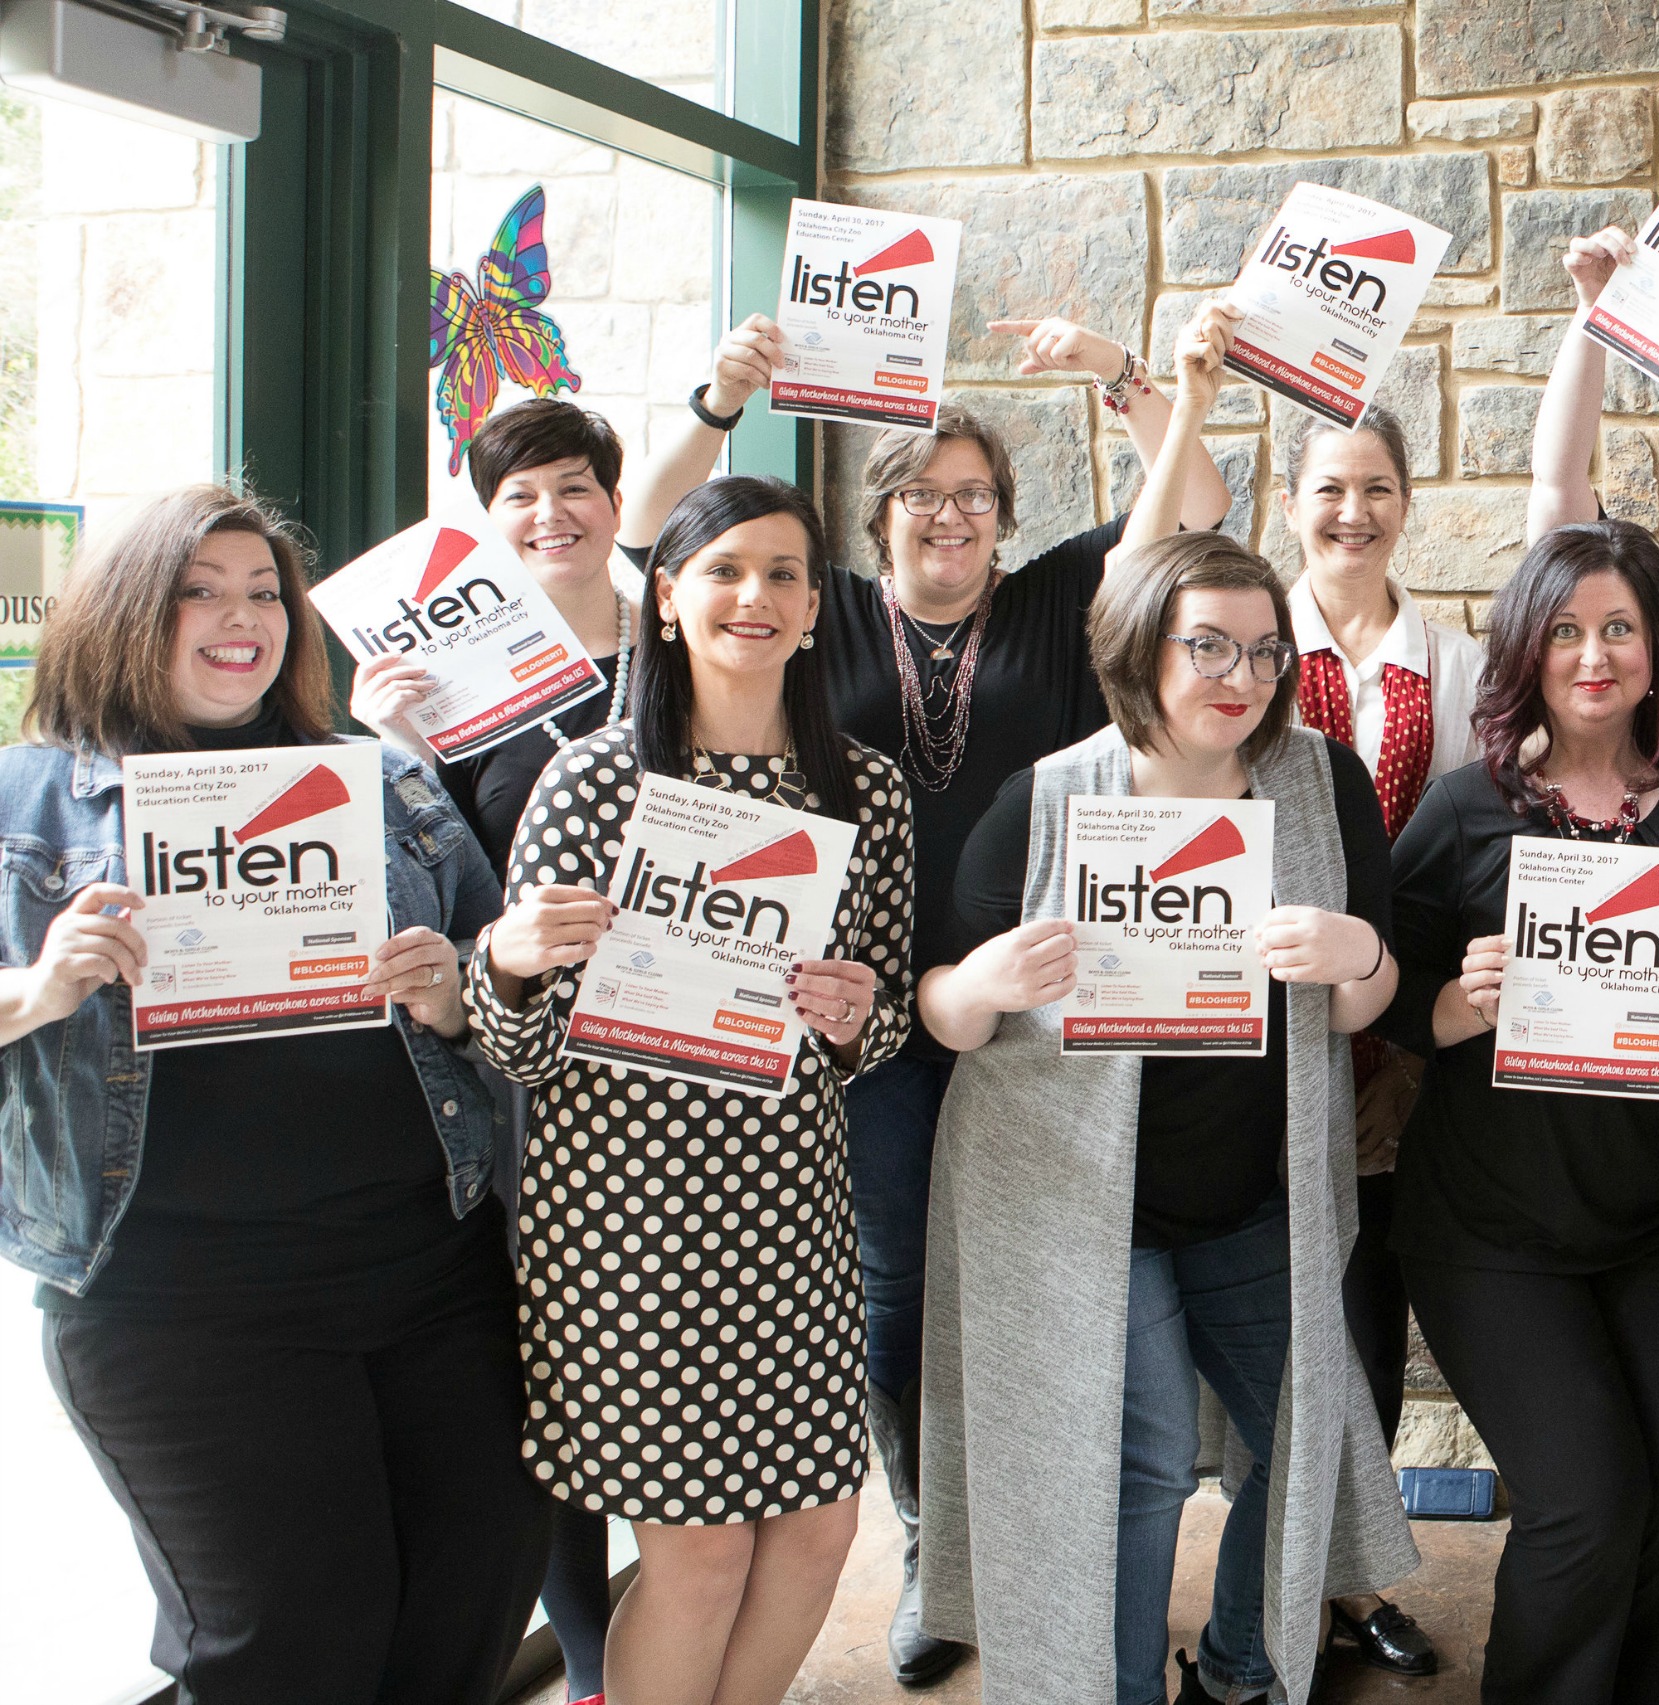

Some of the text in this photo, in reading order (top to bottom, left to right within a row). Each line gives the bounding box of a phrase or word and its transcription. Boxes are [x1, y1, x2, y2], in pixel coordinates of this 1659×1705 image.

[1260, 226, 1386, 313] listen
[790, 254, 918, 318] listen
[1289, 274, 1387, 328] to your mother
[826, 306, 929, 331] to your mother
[1320, 304, 1378, 339] Oklahoma City
[863, 326, 924, 343] Oklahoma City
[876, 375, 926, 387] #BLOGHER17
[351, 578, 506, 657] listen
[420, 597, 524, 656] to your mother
[467, 610, 529, 645] Oklahoma City
[134, 762, 268, 779] Sunday, April 30, 2017
[135, 780, 237, 794] Oklahoma City Zoo
[136, 794, 227, 806] Education Center
[647, 788, 760, 823] Sunday, April 30, 2017
[640, 814, 717, 839] Education Center
[644, 803, 729, 830] Oklahoma City Zoo
[143, 826, 338, 896] listen
[1518, 862, 1593, 875] Oklahoma City Zoo
[203, 881, 357, 911] to your mother
[619, 847, 789, 944] listen
[1077, 864, 1232, 924] listen
[263, 900, 353, 916] Oklahoma City
[665, 919, 797, 962] to your mother
[1122, 921, 1246, 943] to your mother
[1168, 940, 1242, 952] Oklahoma City
[293, 959, 365, 974] #BLOGHER17
[710, 949, 789, 977] Oklahoma City
[1557, 960, 1573, 975] to
[1577, 966, 1614, 984] your
[1188, 995, 1247, 1004] #BLOGHER17
[1600, 981, 1649, 993] Oklahoma
[716, 1015, 781, 1035] #BLOGHER17
[1072, 1022, 1097, 1036] Giving
[1097, 1022, 1146, 1034] Motherhood
[1153, 1022, 1199, 1035] Microphone
[1199, 1025, 1225, 1034] across
[1226, 1023, 1240, 1034] the
[1240, 1022, 1254, 1034] US
[580, 1020, 608, 1039] Giving
[607, 1026, 663, 1047] Motherhood
[669, 1038, 720, 1059] Microphone
[720, 1050, 749, 1065] across
[749, 1054, 764, 1068] the
[764, 1057, 781, 1071] US
[1503, 1056, 1527, 1070] Giving
[1527, 1057, 1574, 1071] Motherhood
[1580, 1061, 1625, 1075] Microphone
[1624, 1066, 1650, 1077] across
